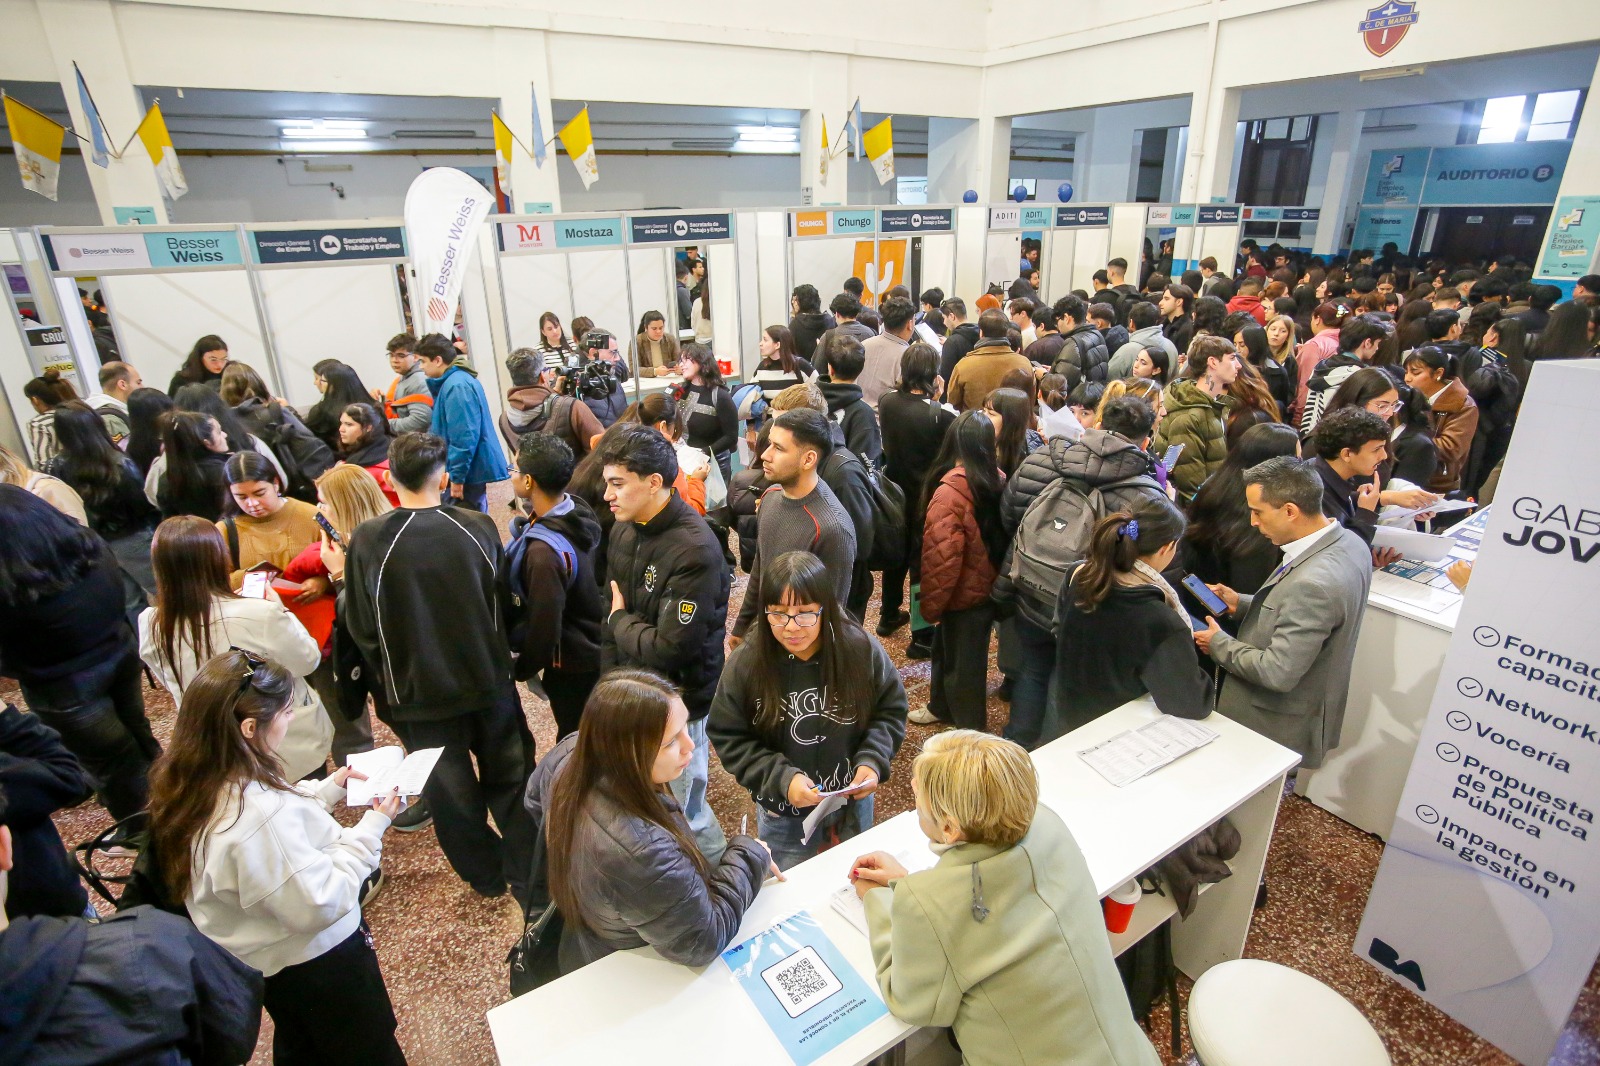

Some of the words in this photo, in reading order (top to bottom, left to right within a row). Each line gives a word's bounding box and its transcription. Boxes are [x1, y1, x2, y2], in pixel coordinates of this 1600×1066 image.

[1388, 16, 1412, 25] MARIA
[1437, 168, 1529, 181] AUDITORIO
[565, 228, 613, 239] Mostaza
[838, 218, 871, 228] Chungo
[1175, 211, 1192, 220] Linser
[166, 237, 220, 250] Besser
[170, 250, 224, 263] Weiss
[344, 243, 369, 251] Trabajo
[434, 243, 457, 297] Besser
[448, 197, 476, 241] Weiss
[1512, 496, 1600, 536] GAB
[1502, 526, 1600, 564] JOV
[1498, 656, 1600, 702] capacit
[1486, 689, 1600, 746] Network
[1476, 722, 1571, 773] Vocería
[1458, 774, 1486, 793] de
[1492, 786, 1588, 841] Política
[1463, 755, 1594, 824] Propuesta
[1452, 787, 1541, 839] Pública
[1436, 831, 1455, 850] la
[1458, 847, 1550, 899] gestión
[1442, 816, 1537, 873] Impacto
[1543, 871, 1576, 893] en
